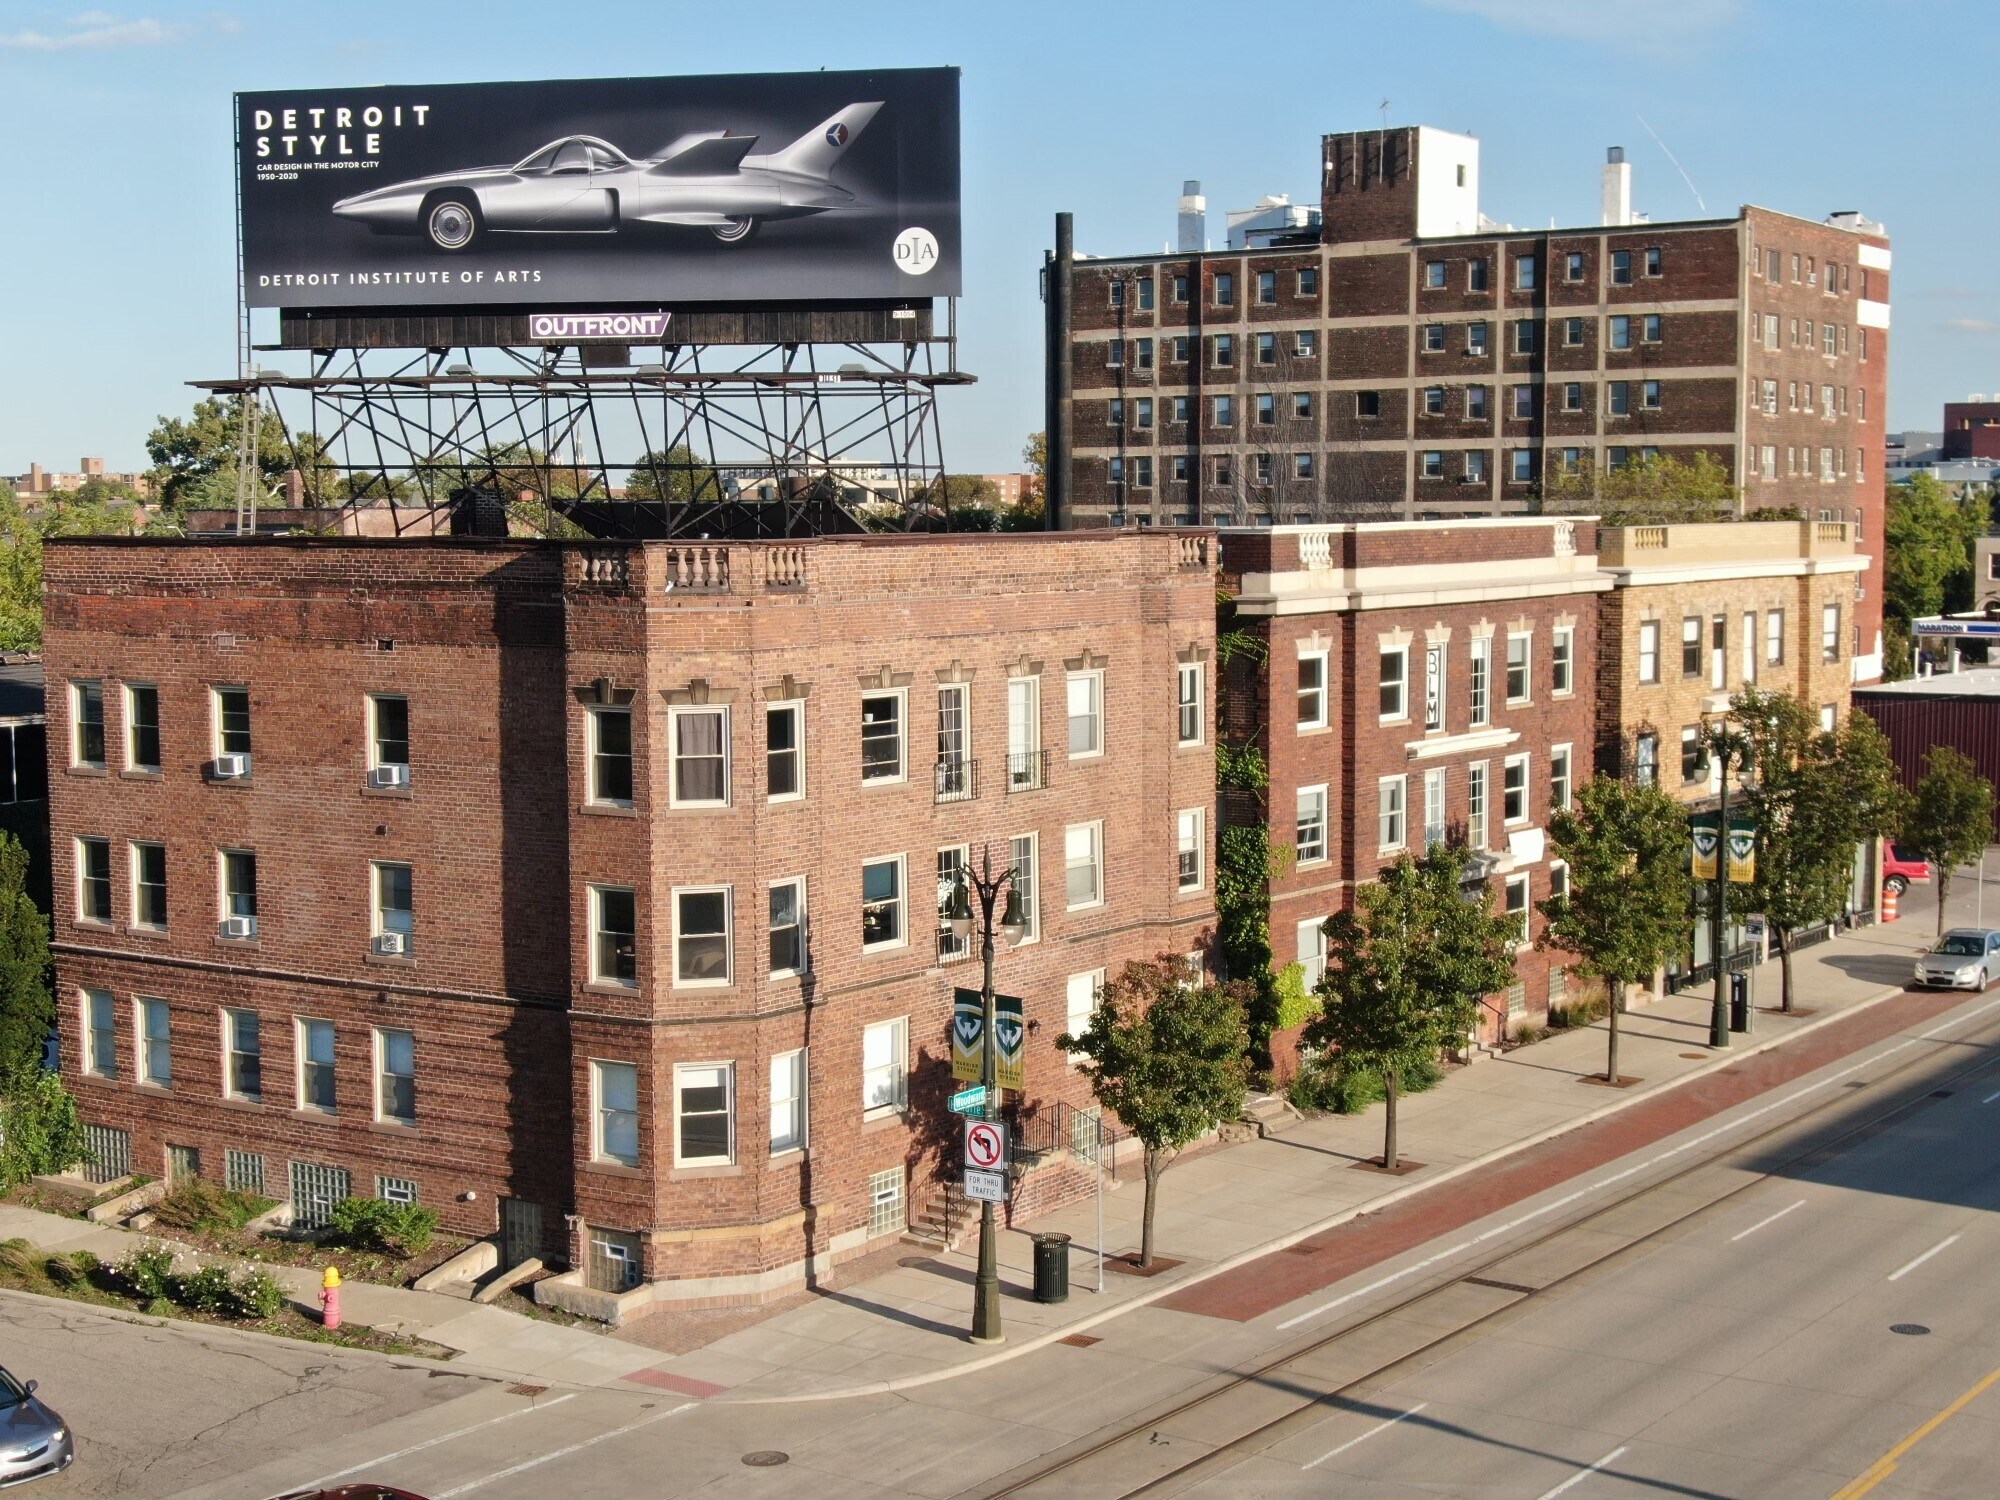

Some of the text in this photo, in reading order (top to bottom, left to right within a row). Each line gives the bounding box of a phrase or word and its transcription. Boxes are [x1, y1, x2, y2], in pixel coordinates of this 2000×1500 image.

[255, 105, 430, 130] DETROIT
[256, 133, 380, 157] STYLE
[274, 163, 302, 171] DESIGN
[304, 162, 313, 170] IN
[331, 161, 360, 169] MOTOR
[896, 237, 936, 265] DIA
[259, 270, 542, 287] DETROIT INSTITUTE OF ARTS
[535, 315, 663, 336] OUTFRONT
[1917, 624, 1963, 632] MARATHON
[955, 1089, 985, 1109] Woodward
[969, 1176, 999, 1187] FOR THRU
[972, 1185, 996, 1197] TRAFFIC
